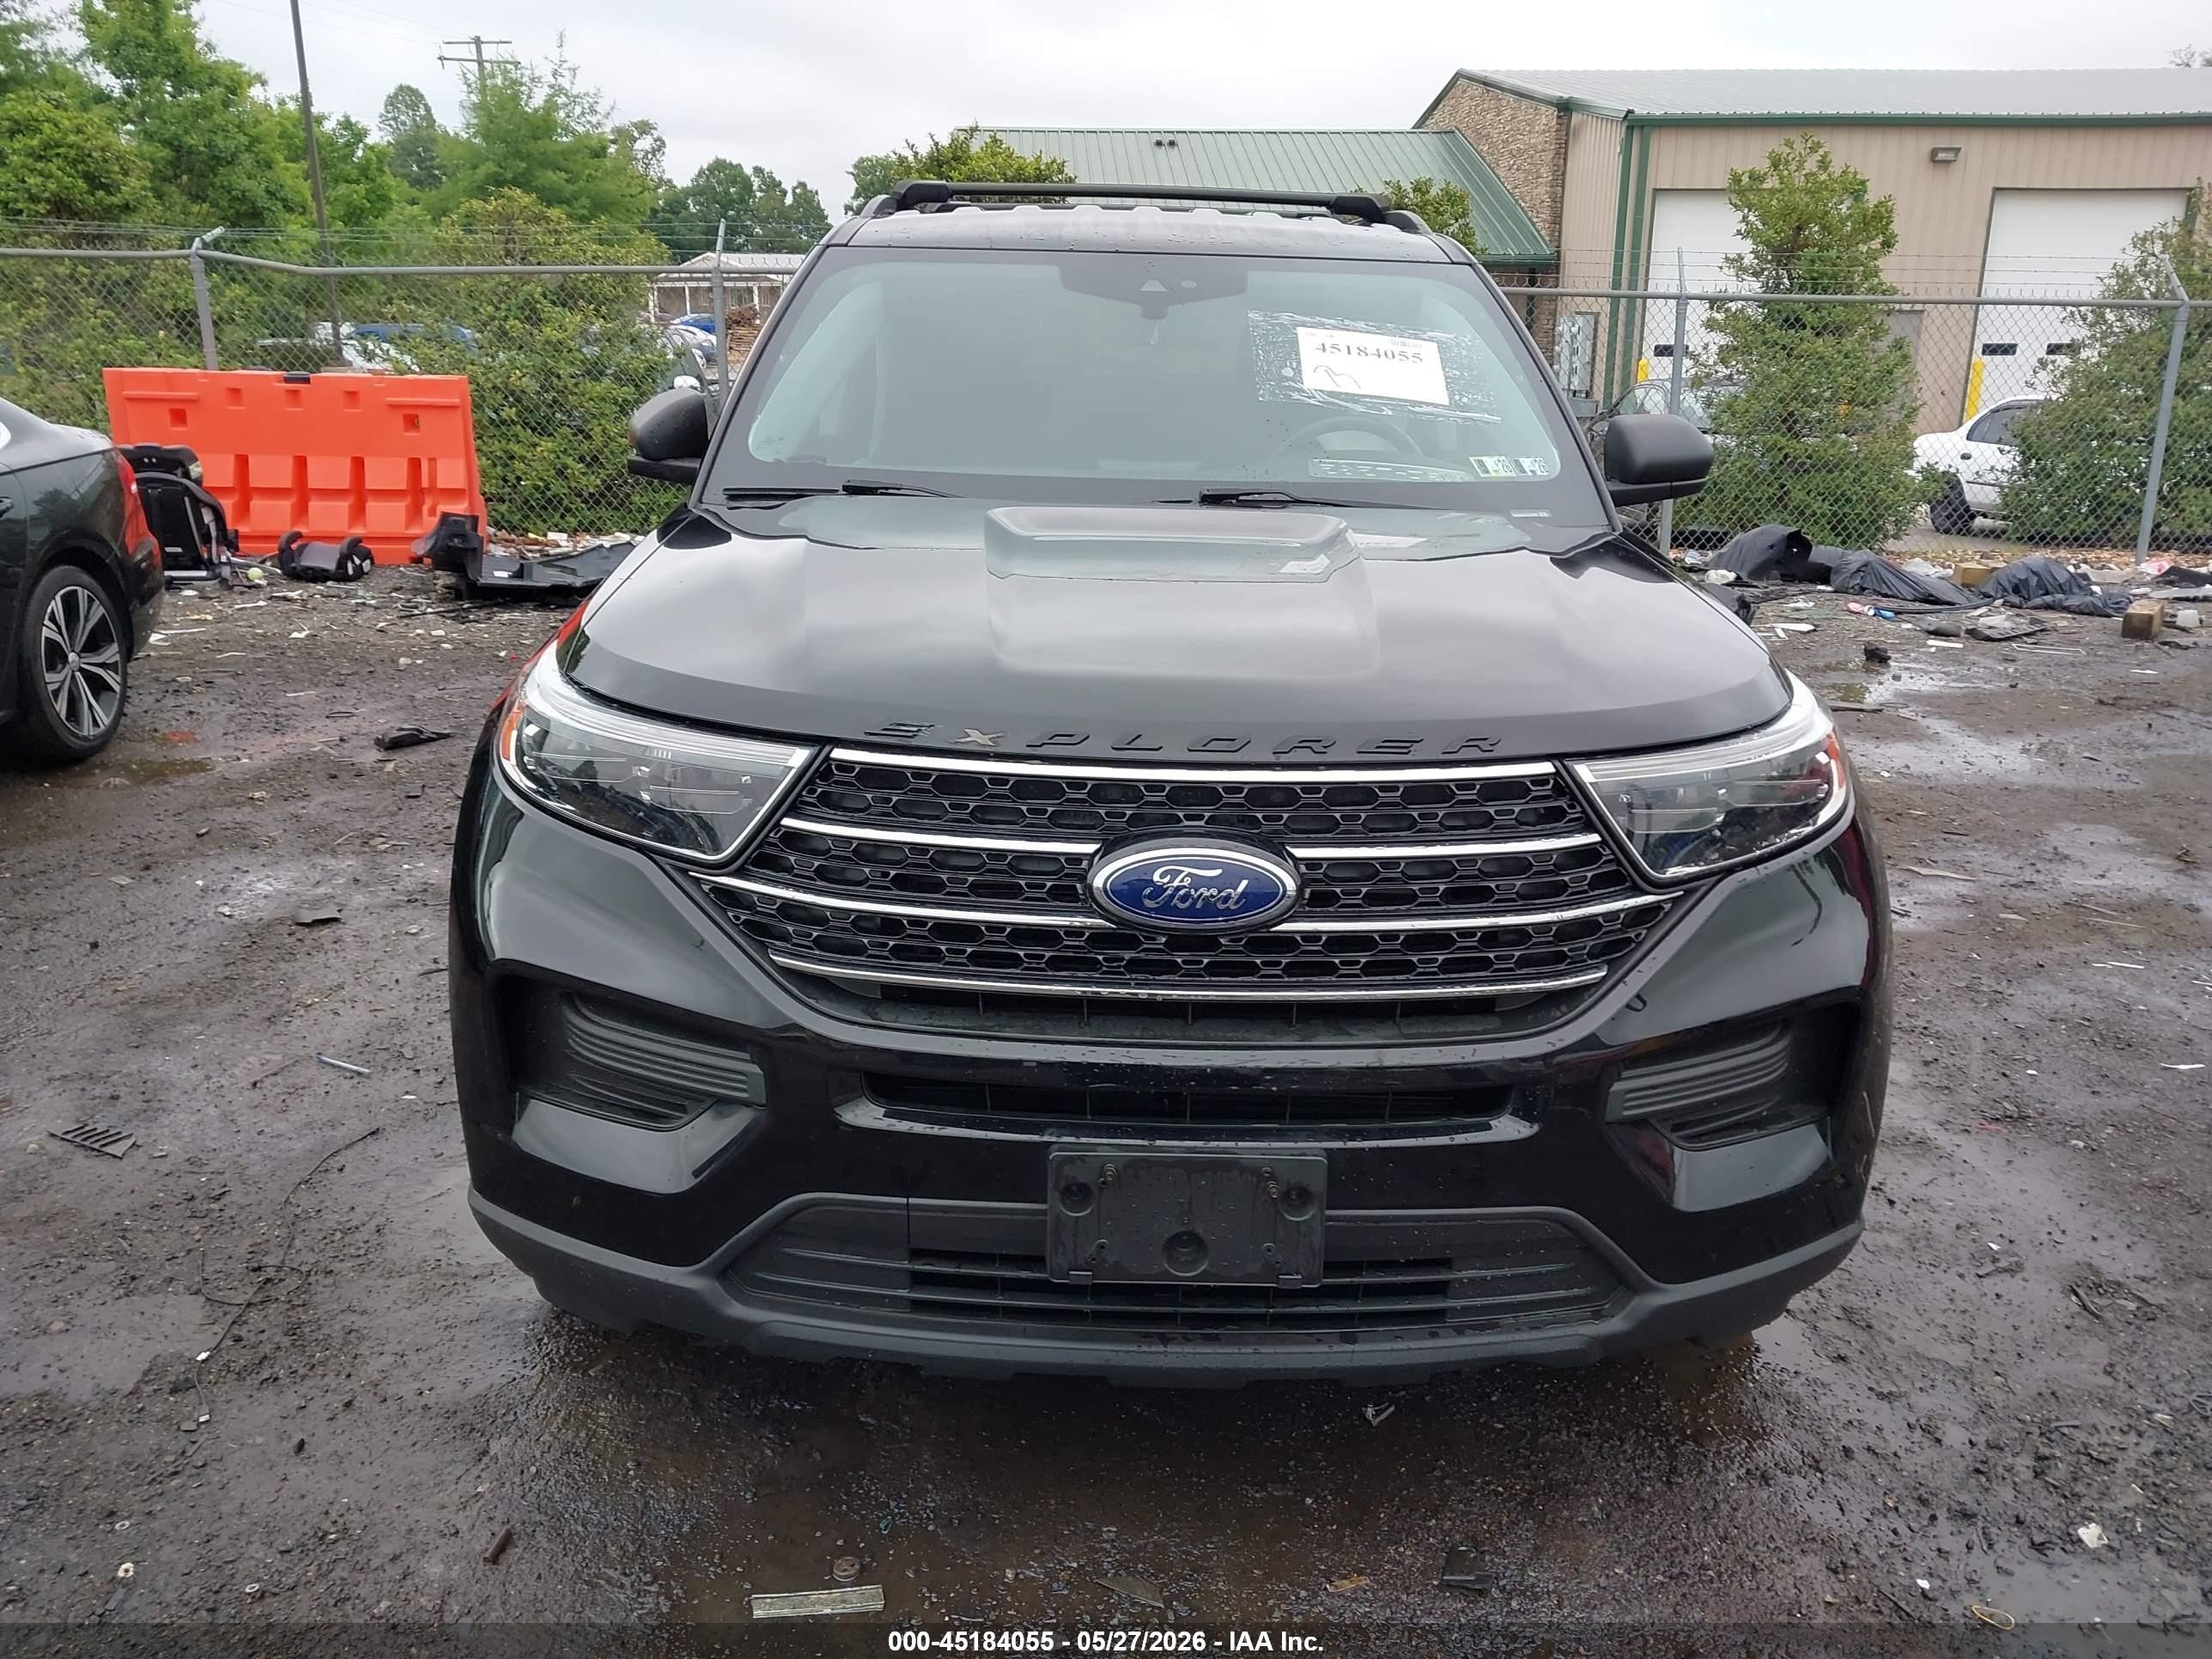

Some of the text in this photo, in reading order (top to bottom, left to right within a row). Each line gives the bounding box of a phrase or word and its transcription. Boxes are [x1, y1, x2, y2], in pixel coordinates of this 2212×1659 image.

[1315, 343, 1423, 363] 45184055
[864, 721, 1503, 755] EXPLORER
[1141, 865, 1249, 910] Ford
